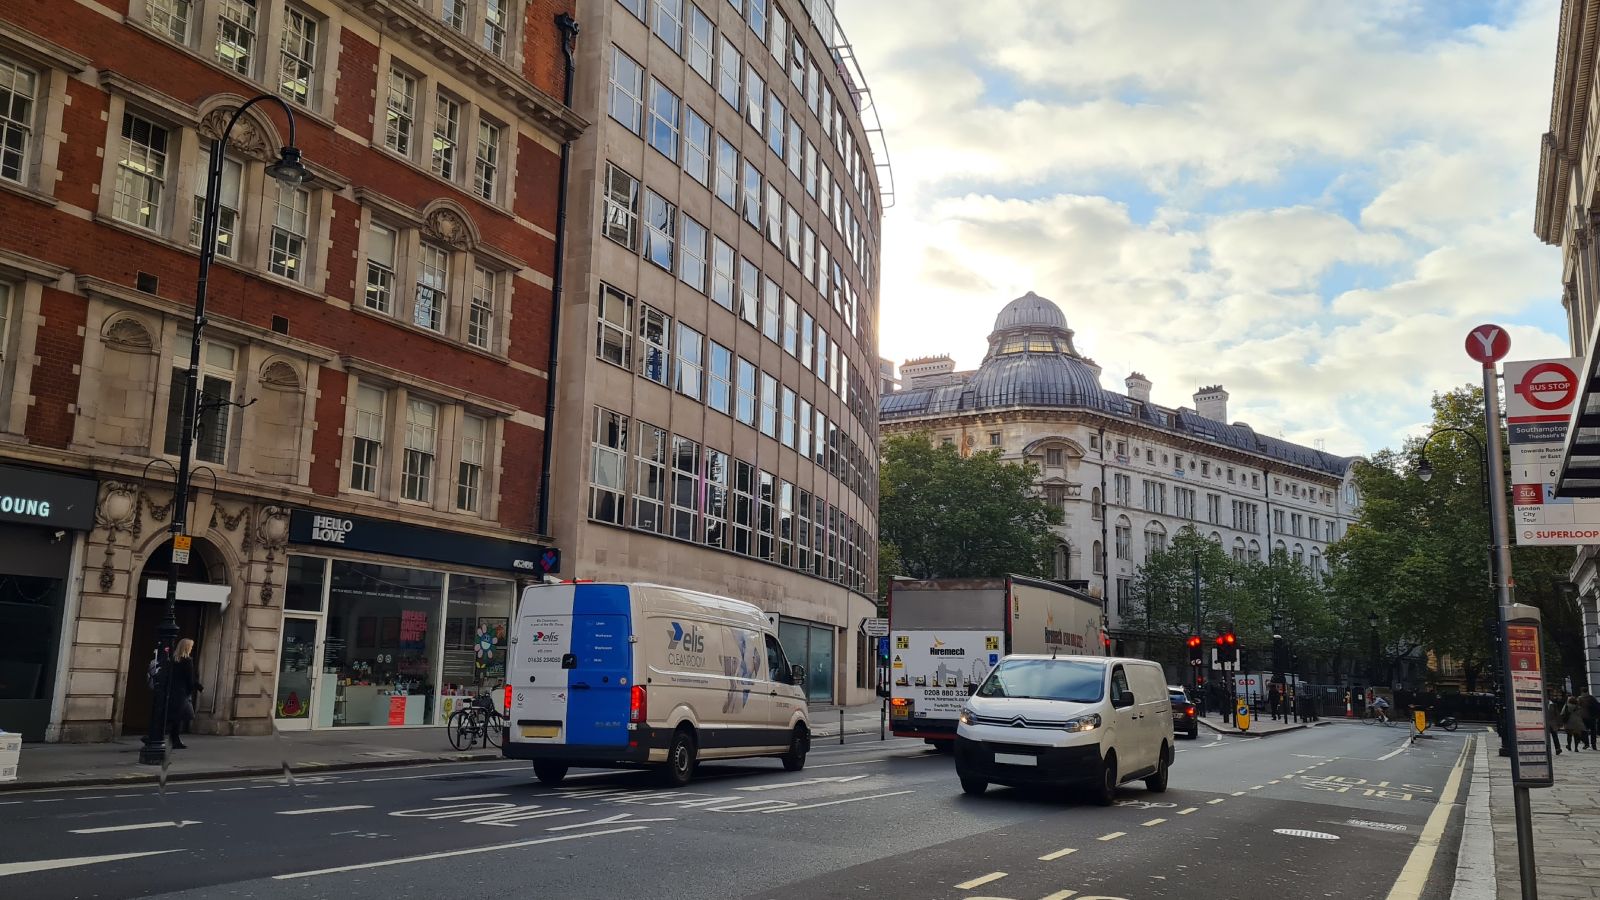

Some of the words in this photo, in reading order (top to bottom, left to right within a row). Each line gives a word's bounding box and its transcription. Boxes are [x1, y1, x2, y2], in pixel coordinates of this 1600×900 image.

[1472, 329, 1499, 357] Y
[1548, 382, 1571, 391] STOP
[1516, 426, 1568, 434] Southampton
[0, 496, 50, 517] OUNG
[313, 515, 353, 532] HELLO
[311, 527, 346, 543] LOVE
[1536, 530, 1599, 539] SUPERLOOP
[542, 631, 560, 642] elis
[683, 624, 705, 654] elis
[929, 647, 965, 656] Hiremech
[668, 652, 706, 668] CLEANROOM
[533, 788, 798, 813] AHEAD
[387, 803, 677, 832] ONLY
